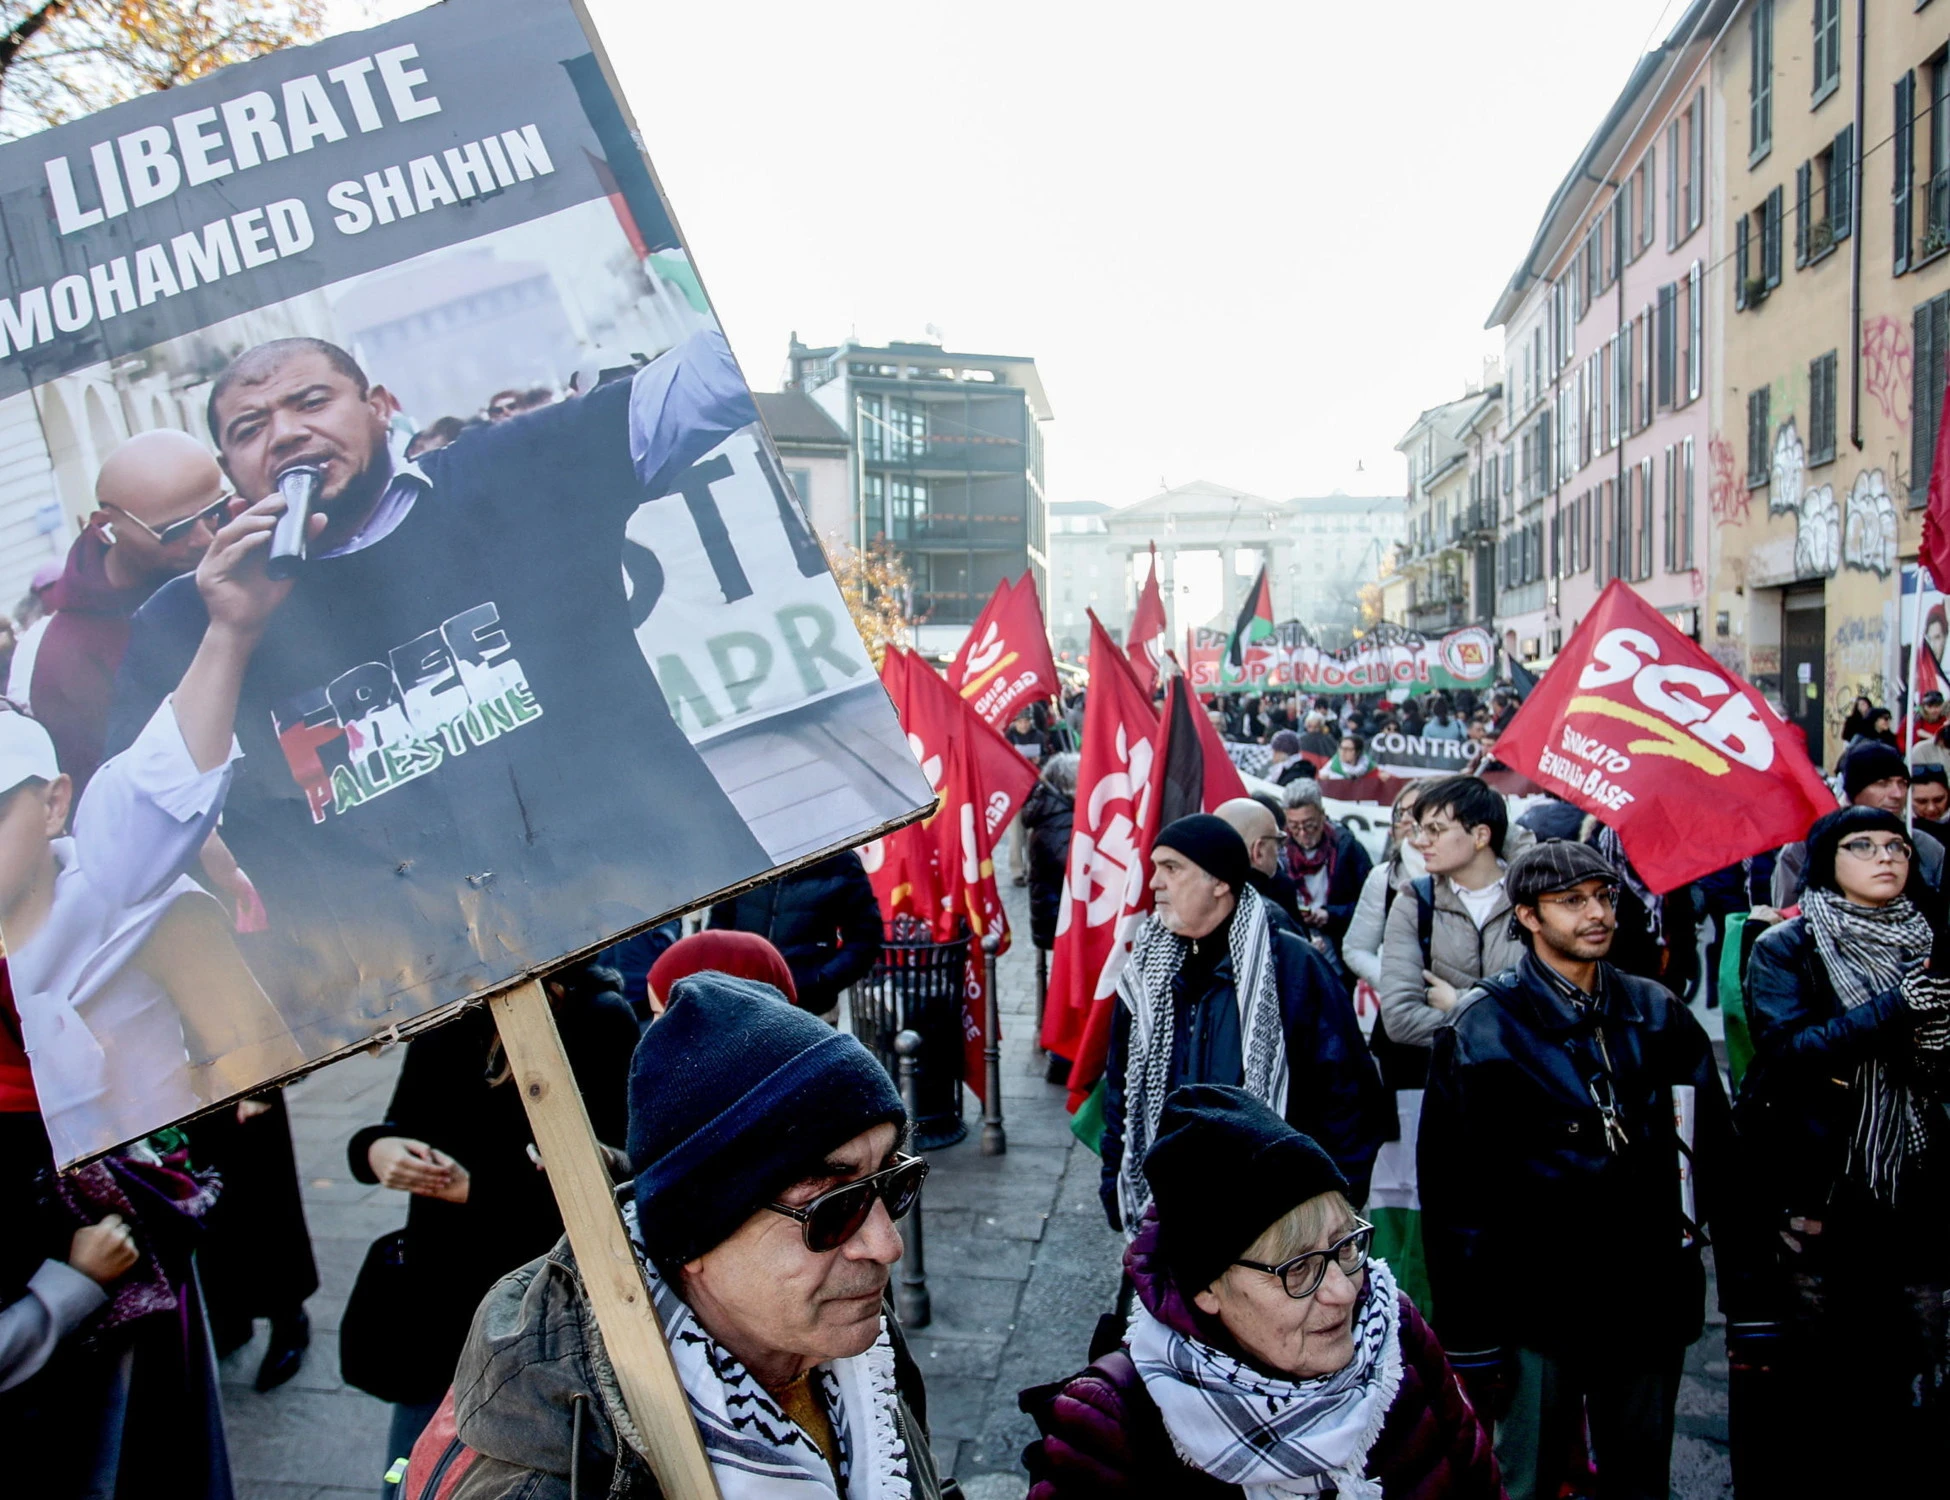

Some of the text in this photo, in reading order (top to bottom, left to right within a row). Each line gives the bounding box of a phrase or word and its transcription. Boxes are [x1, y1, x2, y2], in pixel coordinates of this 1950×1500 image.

[44, 43, 441, 236] LIBERATE
[0, 123, 555, 359] MOHAMED SHAHIN
[305, 682, 543, 824] PALESTINE
[1370, 732, 1483, 761] CONTRO
[1582, 768, 1636, 811] BASE
